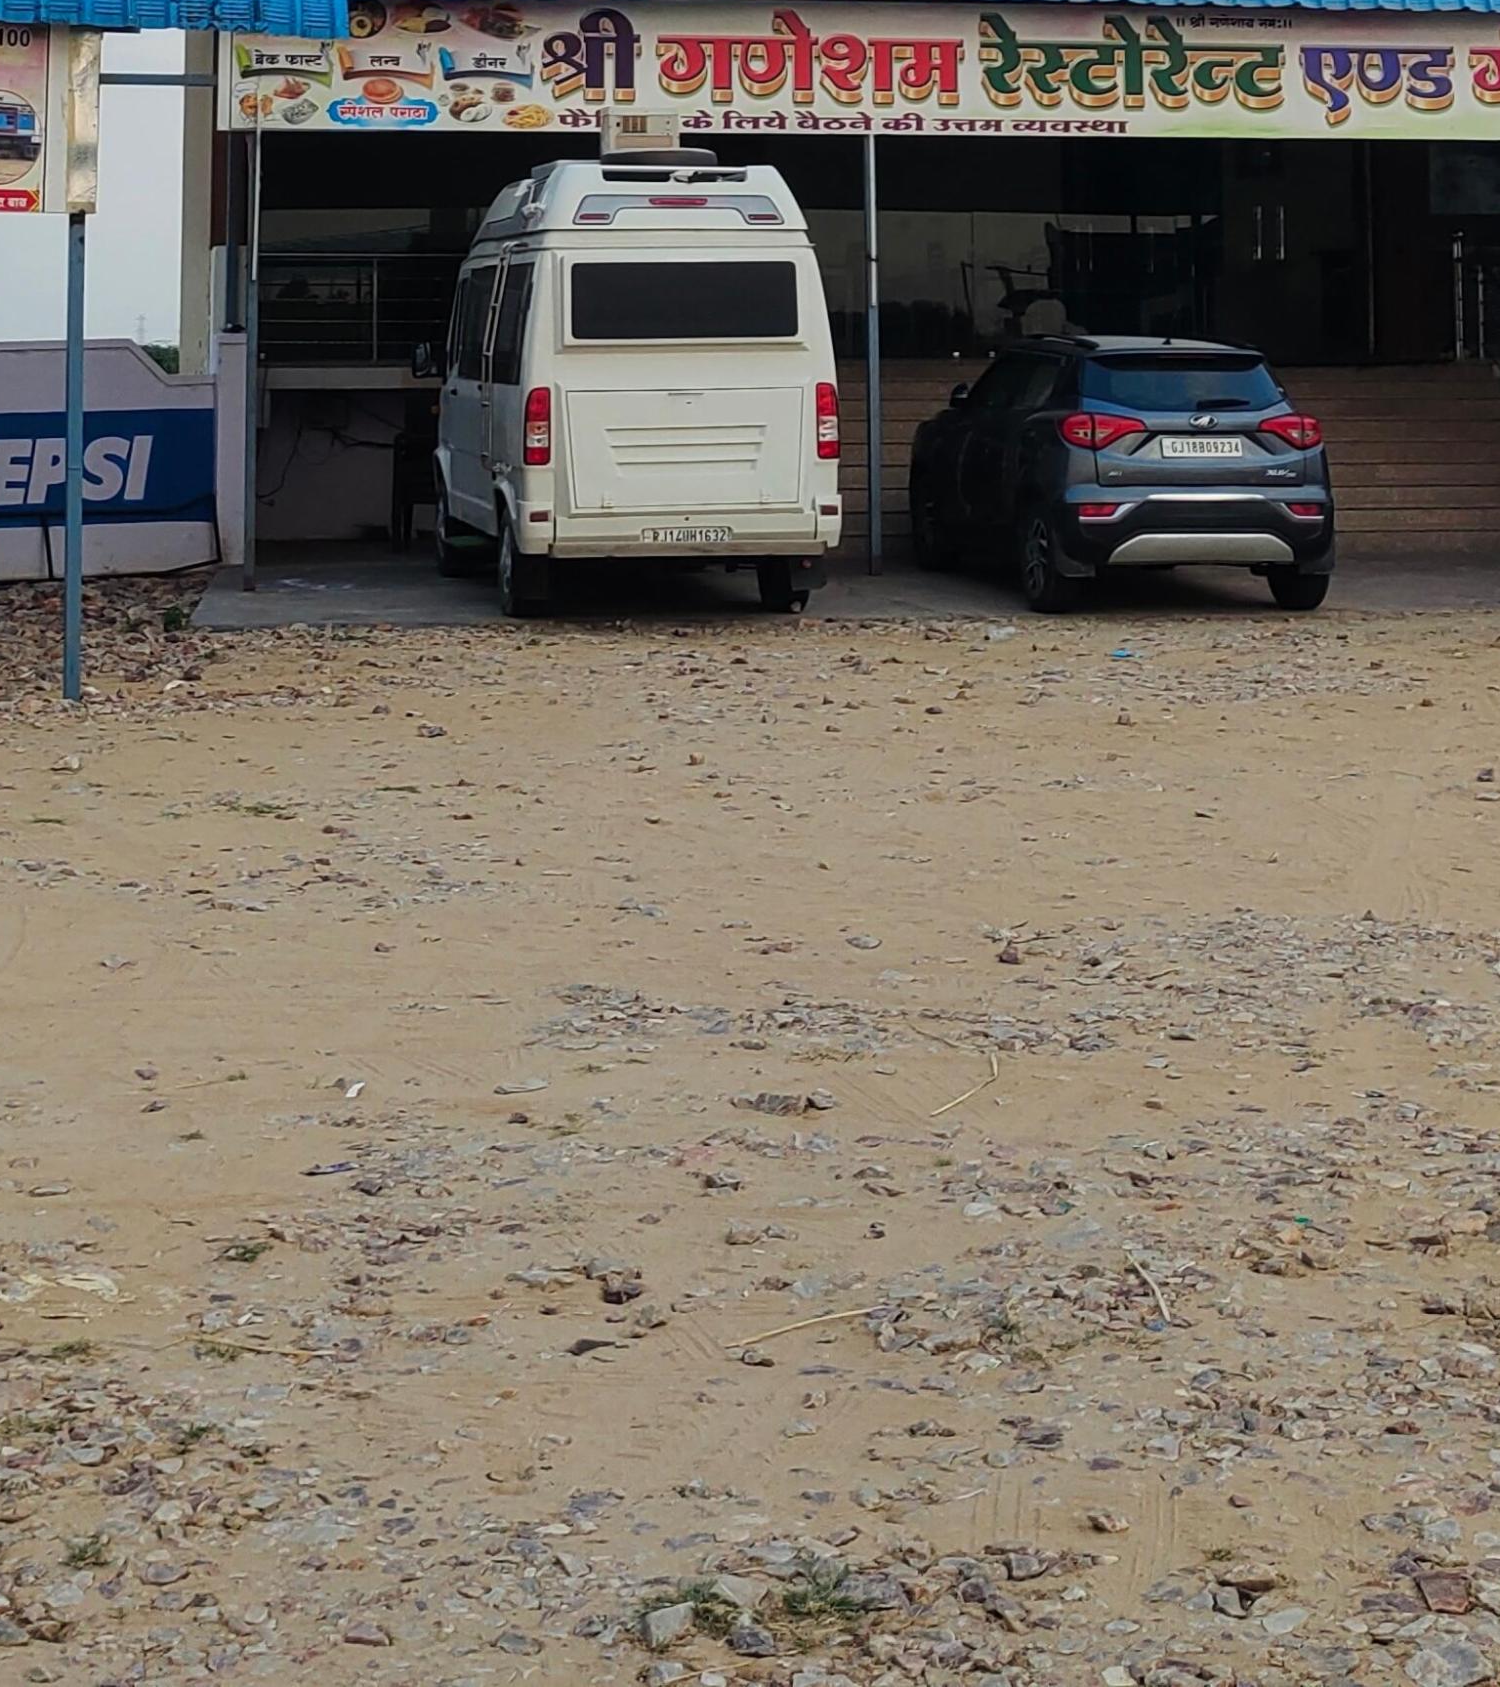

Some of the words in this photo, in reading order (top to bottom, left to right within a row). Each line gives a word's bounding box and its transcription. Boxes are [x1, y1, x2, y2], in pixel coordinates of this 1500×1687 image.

[540, 7, 642, 105] श्री
[656, 8, 965, 105] गणेशम
[978, 12, 1286, 110] रेस्टोरेन्ट
[1299, 45, 1455, 127] एण्ड
[681, 110, 714, 129] के
[722, 110, 789, 130] लिये
[796, 111, 873, 132] बैठने
[882, 111, 925, 132] की
[933, 117, 1004, 133] उत्तम
[1011, 119, 1131, 135] व्यवस्था
